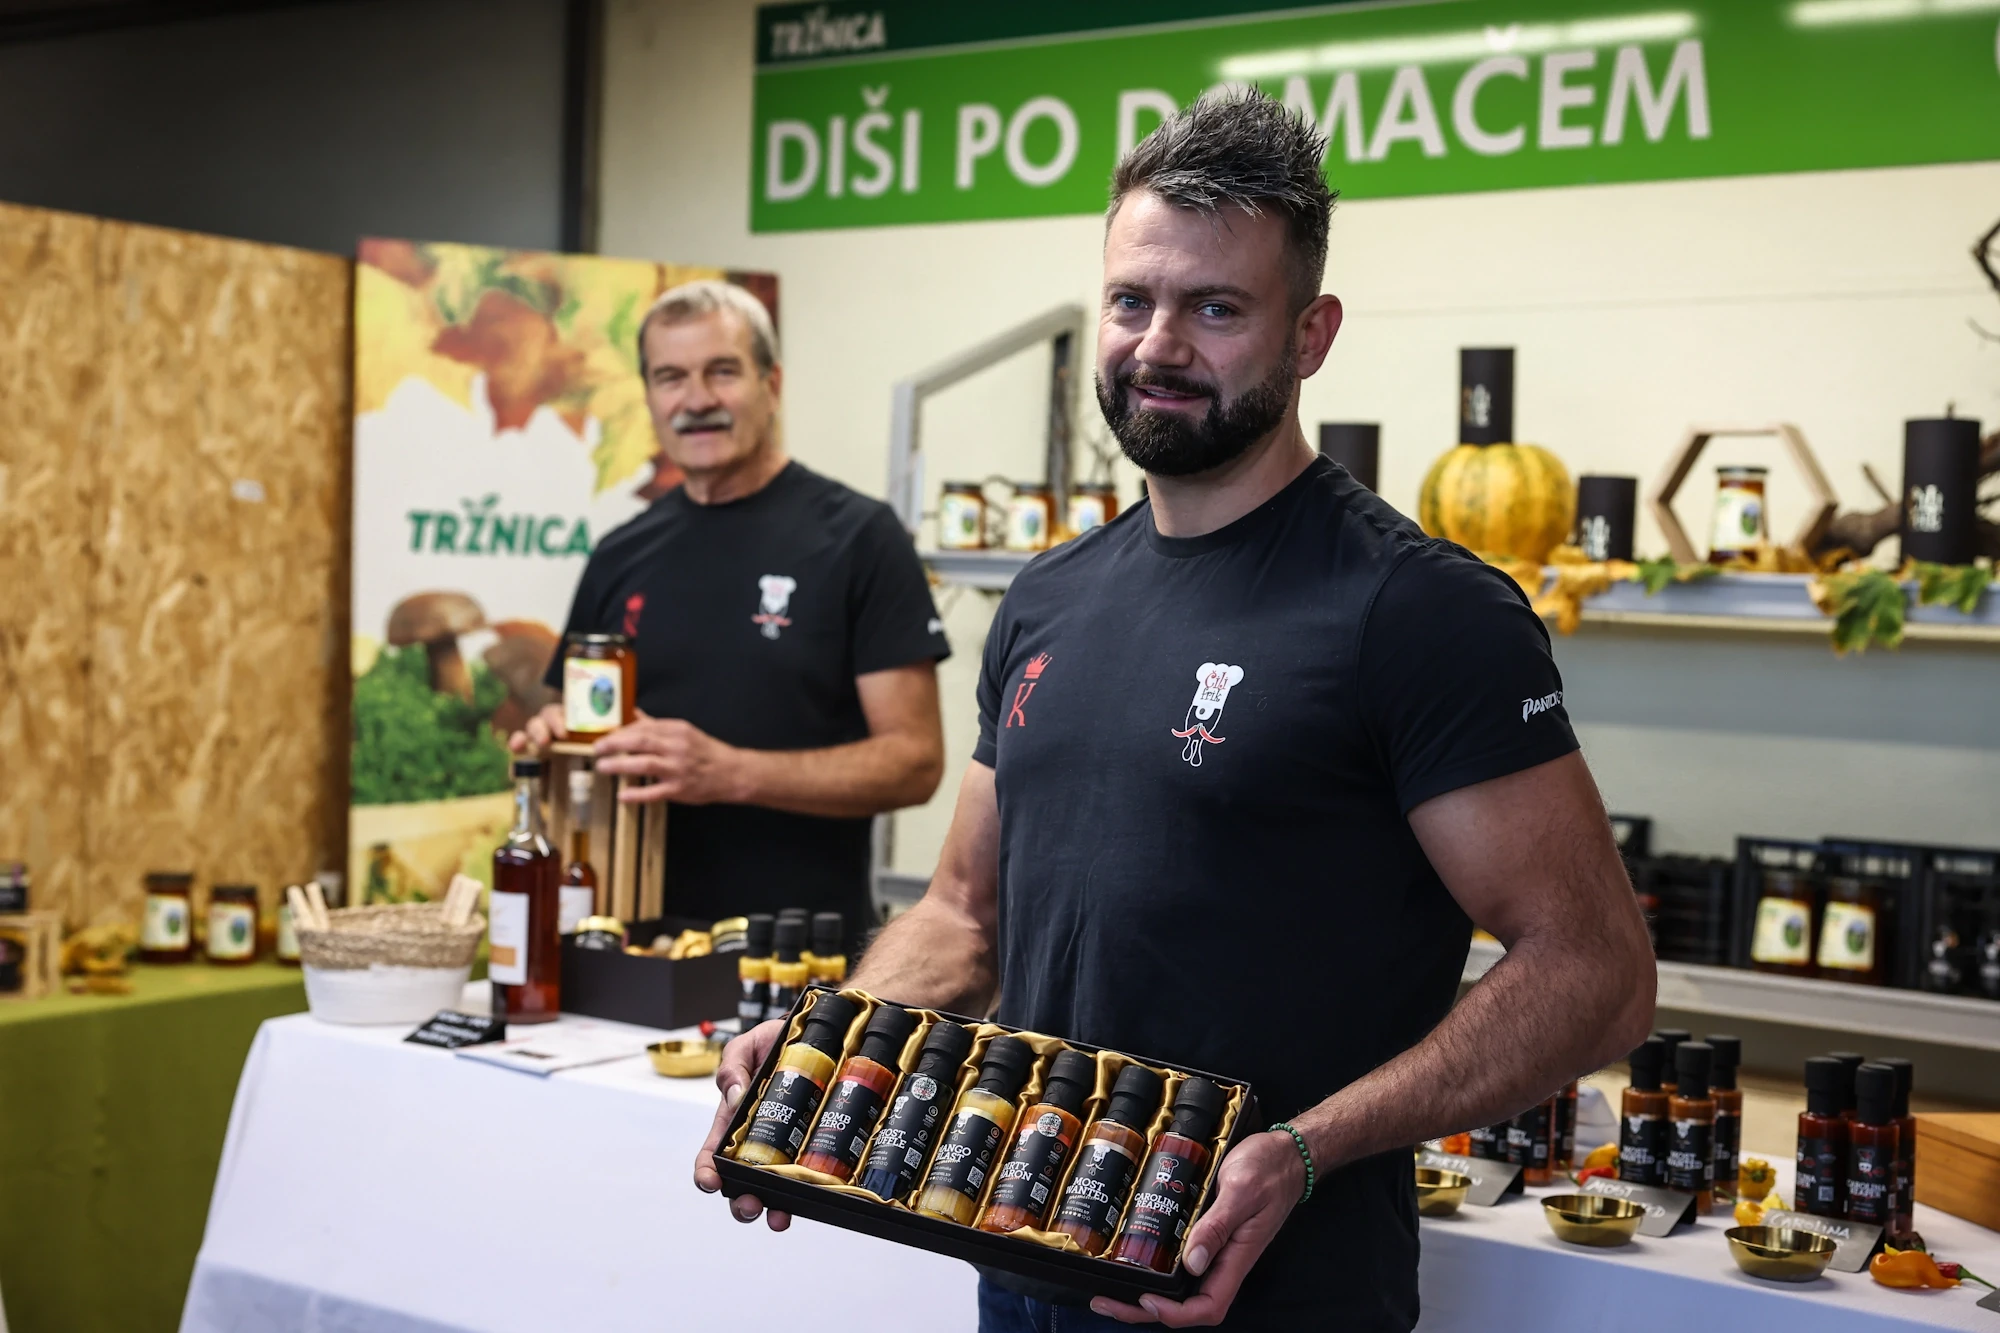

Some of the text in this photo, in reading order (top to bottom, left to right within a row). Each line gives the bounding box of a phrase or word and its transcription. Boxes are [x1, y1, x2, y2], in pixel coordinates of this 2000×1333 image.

[765, 24, 1711, 202] DIŠI PO DMAČEM
[407, 492, 595, 558] TRŽNICA
[1204, 670, 1229, 690] Čili
[756, 1108, 792, 1125] SMOKE
[759, 1100, 797, 1118] DESERT
[821, 1111, 852, 1124] BOMB
[818, 1119, 846, 1131] ZERO
[1073, 1176, 1106, 1192] MOST
[1586, 1181, 1644, 1198] MOST
[1065, 1185, 1109, 1204] WANTED
[1134, 1192, 1180, 1213] CAROLINA
[1135, 1199, 1173, 1217] REAPER
